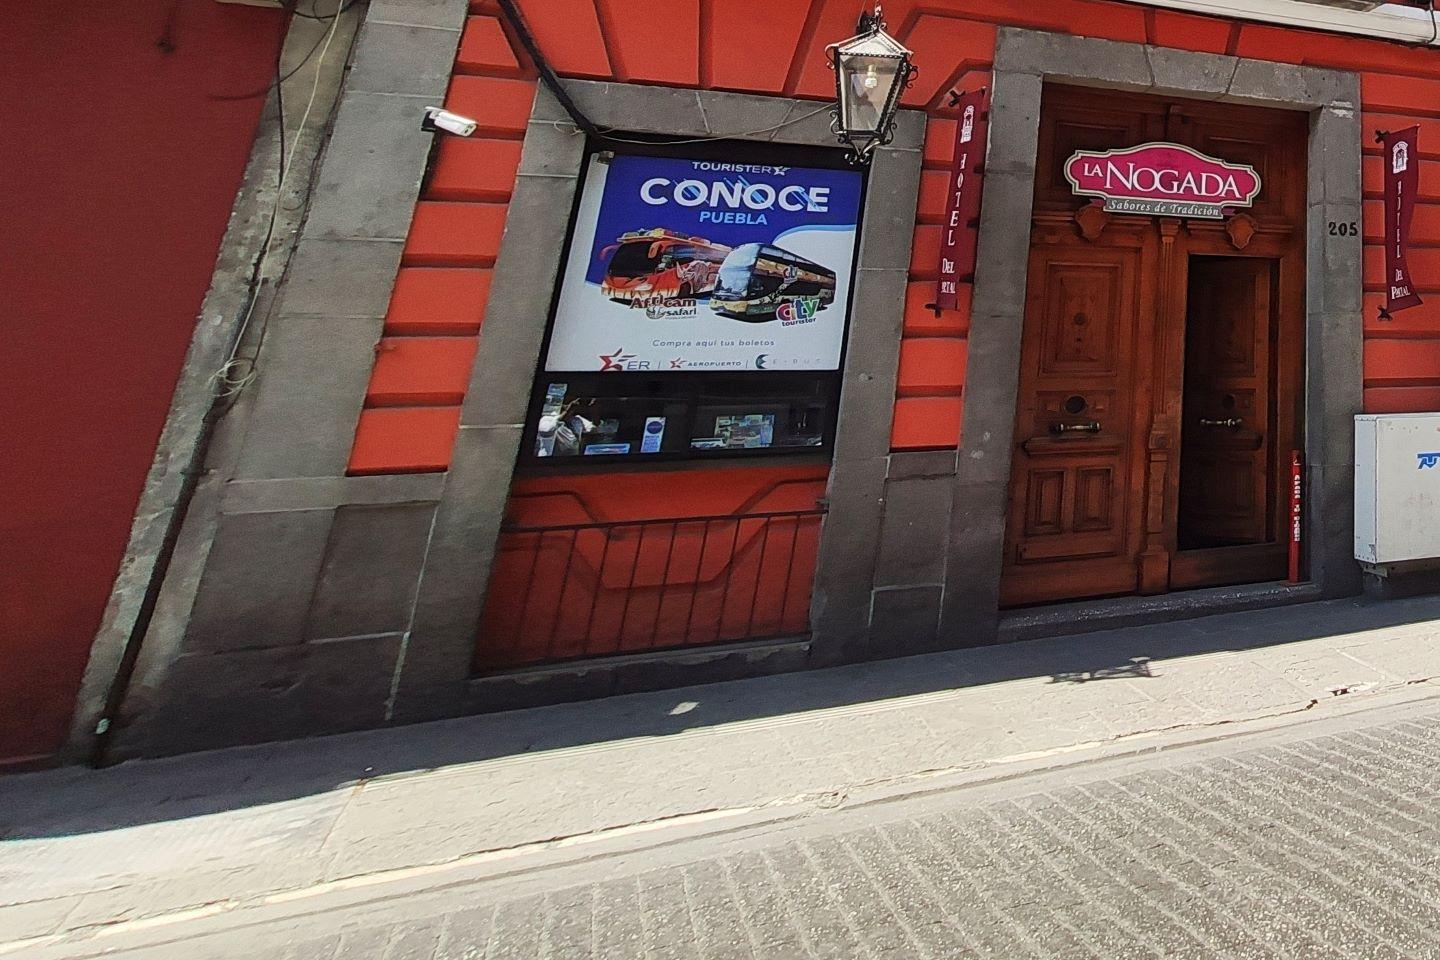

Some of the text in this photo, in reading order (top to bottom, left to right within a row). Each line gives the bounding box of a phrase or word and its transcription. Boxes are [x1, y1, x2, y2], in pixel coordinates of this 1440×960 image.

[692, 161, 772, 174] TOURISTER
[1083, 160, 1242, 199] LA NOGADA
[640, 177, 830, 212] CONOCE
[1108, 200, 1220, 217] Sabores de Tradición
[699, 210, 768, 226] PUEBLA
[1328, 221, 1358, 237] 205
[652, 339, 692, 349] Compra
[720, 339, 735, 347] tus
[738, 339, 775, 347] boletos
[687, 360, 742, 368] AEROPUERTO
